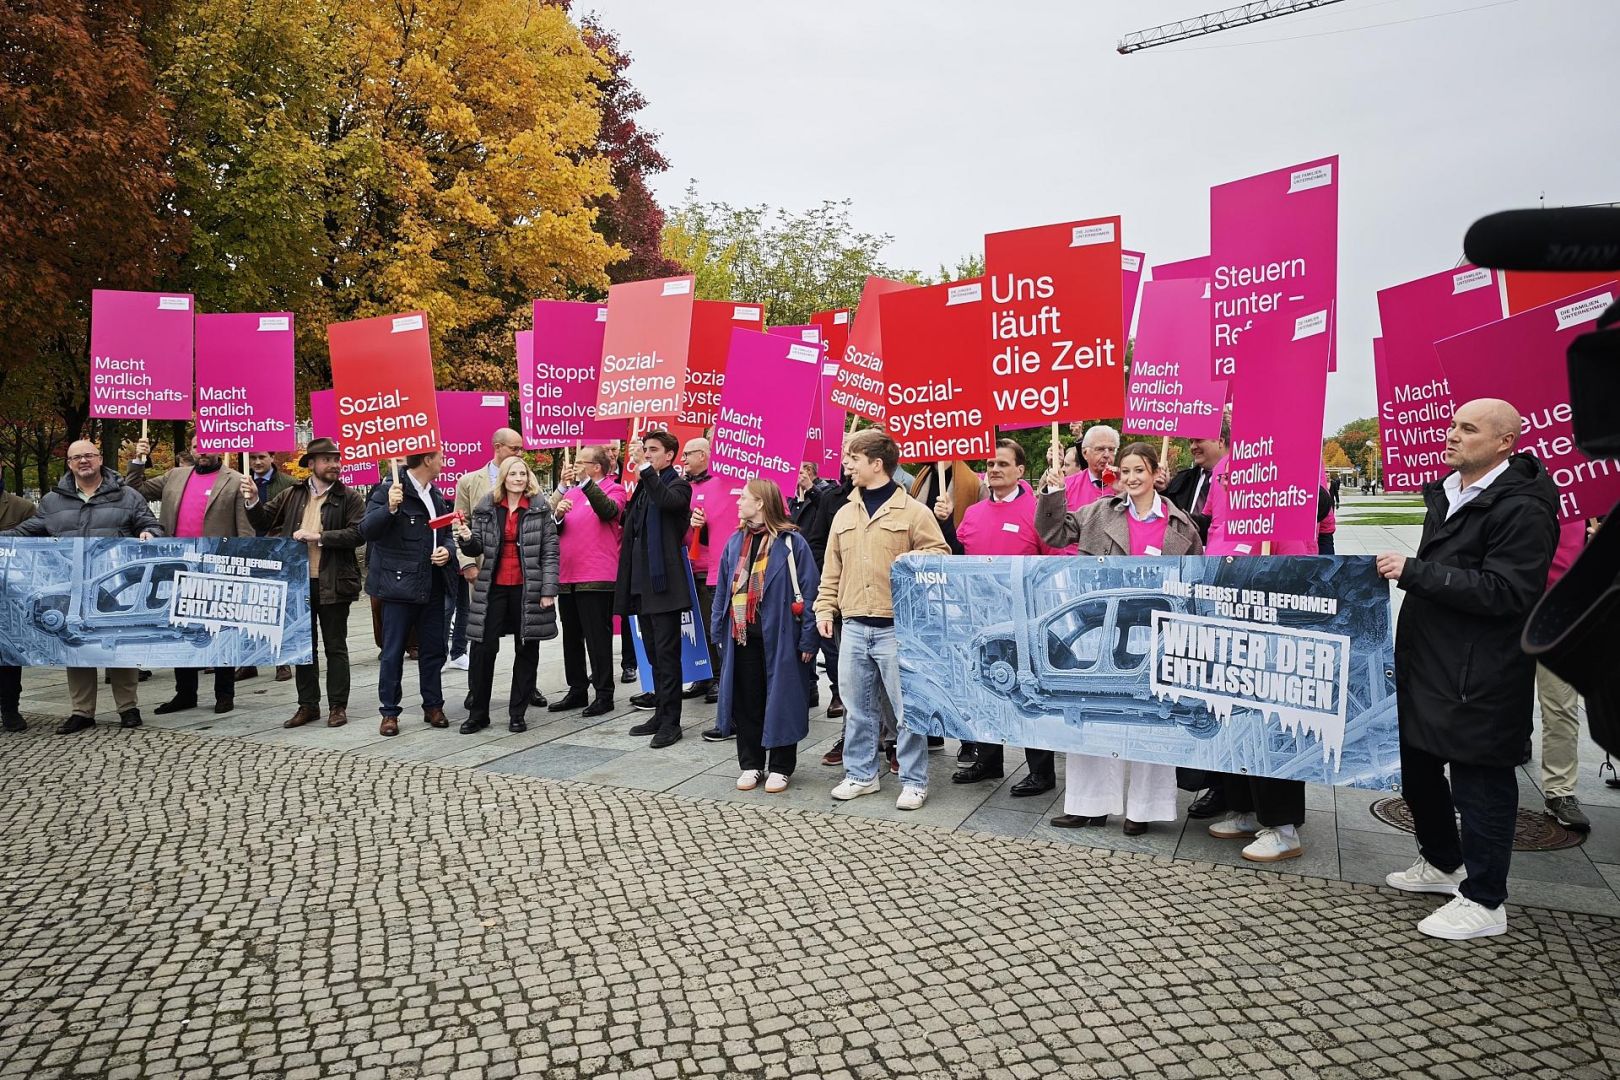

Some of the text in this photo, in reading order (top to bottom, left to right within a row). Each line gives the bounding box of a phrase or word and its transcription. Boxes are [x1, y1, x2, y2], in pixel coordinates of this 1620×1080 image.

[1214, 258, 1306, 290] Steuern
[991, 273, 1056, 304] Uns
[1215, 291, 1283, 319] runter
[1562, 302, 1608, 321] UNTERNEHMER
[1571, 300, 1600, 313] FAMILIEN
[991, 305, 1062, 341] läuft
[94, 357, 145, 370] Macht
[602, 351, 664, 374] Sozial-
[992, 338, 1116, 376] die Zeit
[94, 373, 152, 386] endlich
[536, 363, 596, 384] Stoppt
[1134, 361, 1180, 378] Macht
[200, 387, 246, 400] Macht
[536, 382, 562, 398] die
[600, 375, 676, 398] systeme
[837, 368, 884, 396] system
[888, 378, 964, 406] Sozial-
[1131, 379, 1184, 396] endlich
[1394, 378, 1451, 404] Macht
[94, 386, 188, 402] Wirtschafts-
[339, 389, 410, 416] Sozial-
[598, 394, 680, 416] sanieren!
[830, 388, 886, 420] sanieren
[993, 378, 1071, 416] weg!
[94, 403, 152, 416] wende!
[200, 402, 254, 416] endlich
[720, 406, 764, 430] Macht
[1129, 397, 1219, 416] Wirtschafts-
[200, 418, 291, 433] Wirtschafts-
[342, 412, 428, 440] systeme
[536, 420, 584, 436] welle!
[889, 408, 982, 436] systeme
[1126, 416, 1179, 432] wende!
[200, 435, 254, 449] wende!
[344, 429, 437, 460] sanieren!
[717, 426, 766, 449] endlich
[1232, 436, 1274, 462] Macht
[715, 440, 796, 474] Wirtschafts-
[1230, 462, 1278, 486] endlich
[1228, 487, 1314, 511] Wirtschafts-
[1227, 512, 1275, 536] wende!
[183, 552, 202, 562] OHNE
[204, 554, 230, 565] HERBST
[231, 556, 245, 566] DER
[215, 564, 250, 576] FOLGT DER
[914, 572, 948, 584] INSM
[180, 577, 281, 608] WINTER DER
[1162, 580, 1338, 616] OHNE HERBST DER REFORMEN
[178, 598, 278, 624] ENTLASSUNGEN
[1214, 601, 1278, 623] FOLGT DER
[1162, 620, 1336, 681] WINTER DER
[1162, 655, 1333, 710] ENTLASSUNGEN
